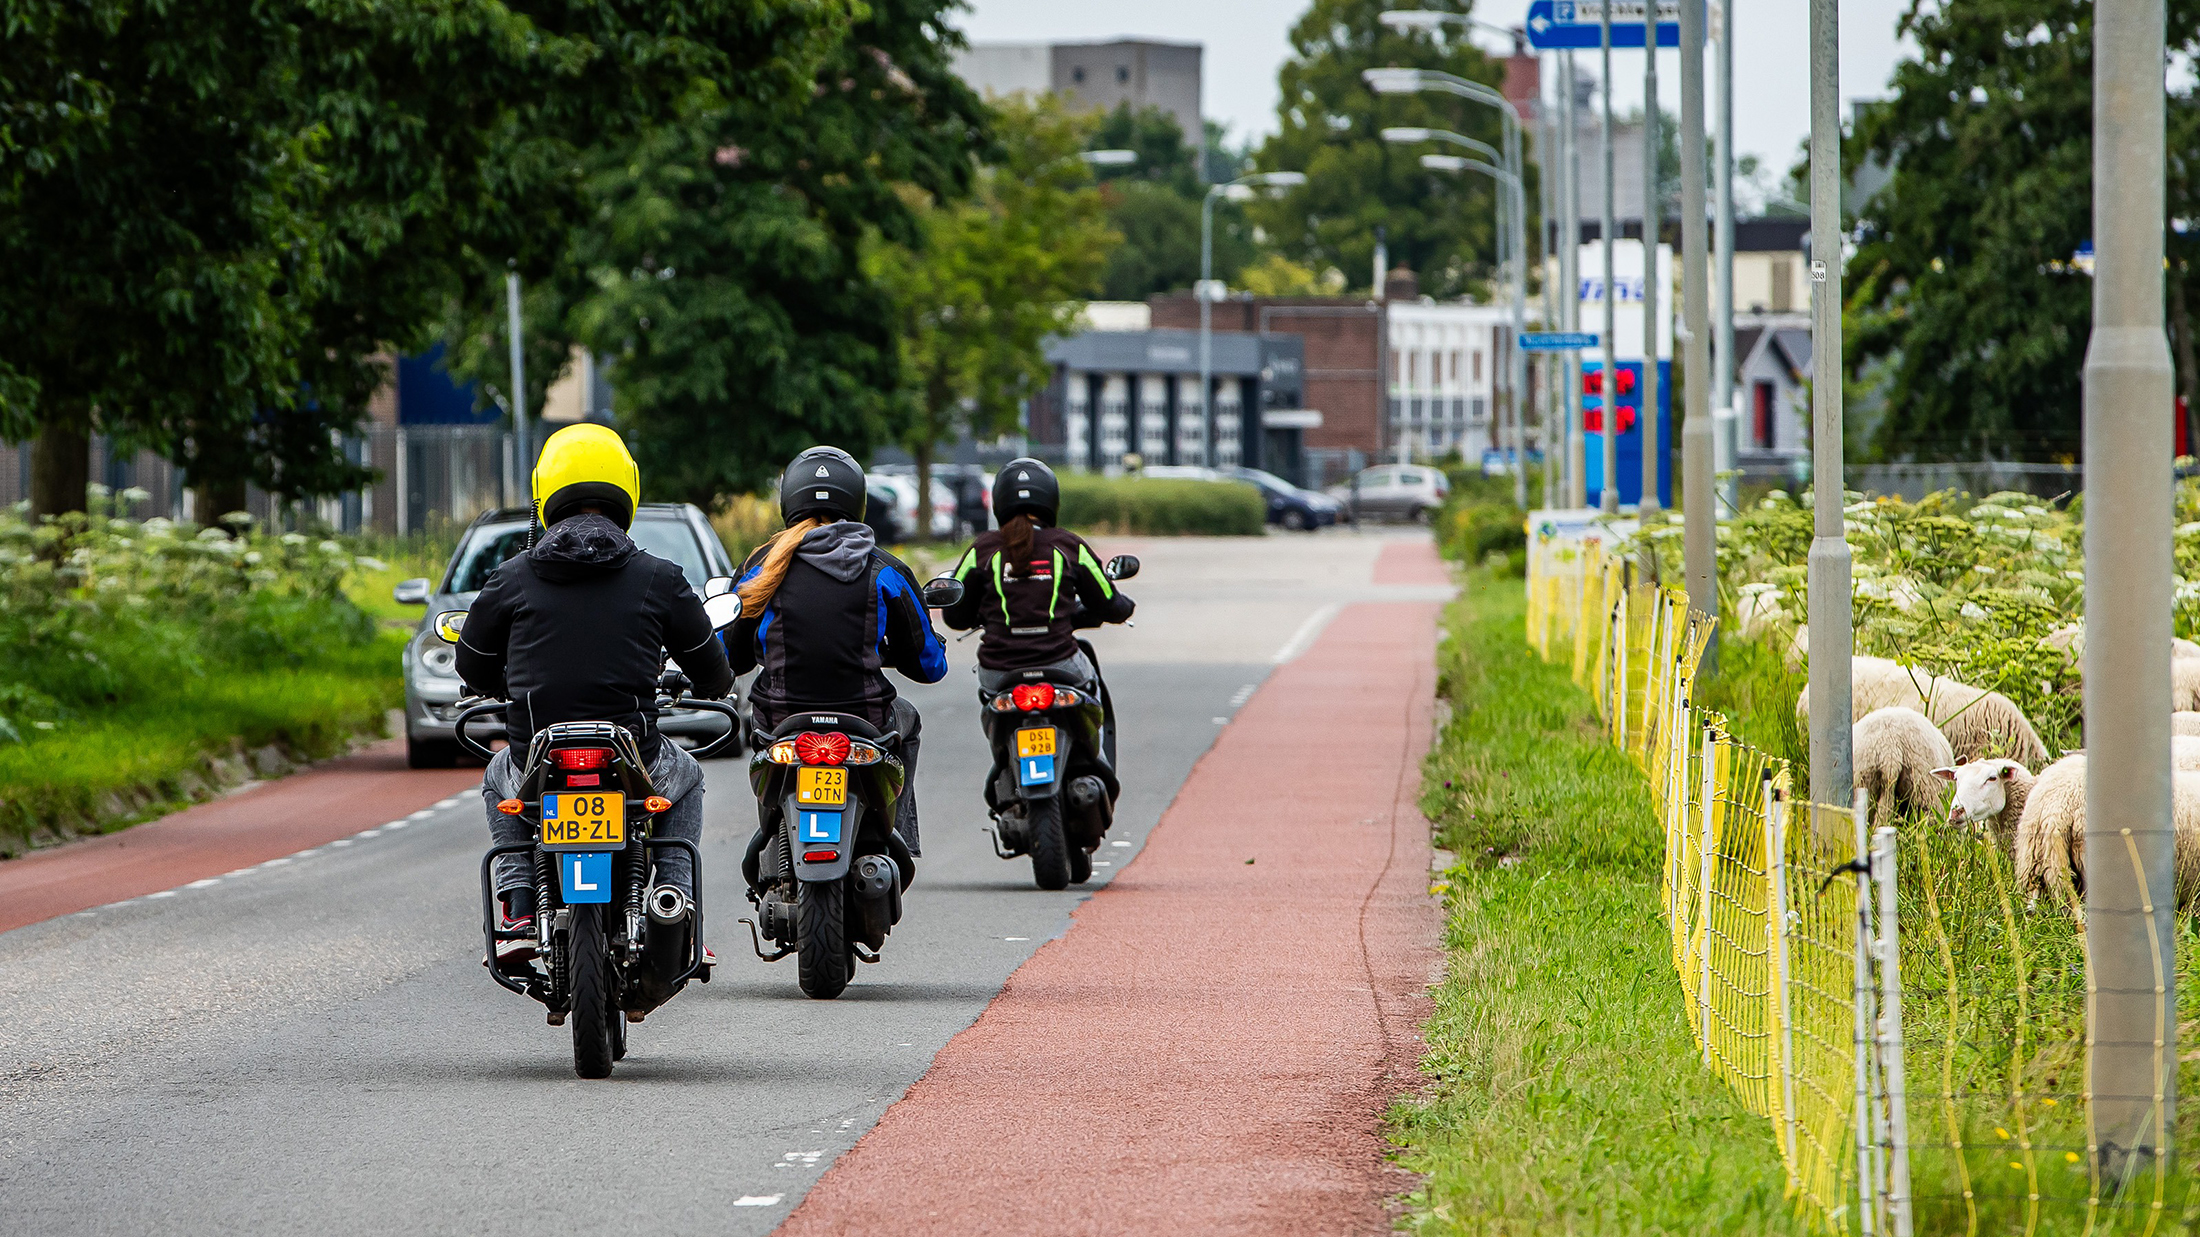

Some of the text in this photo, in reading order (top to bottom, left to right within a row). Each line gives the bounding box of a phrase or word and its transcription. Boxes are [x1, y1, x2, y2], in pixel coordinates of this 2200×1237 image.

[811, 716, 838, 724] YAMAHA
[1030, 731, 1050, 741] DSL
[1030, 743, 1051, 753] 92B
[815, 771, 842, 785] F23
[1029, 760, 1047, 779] L
[573, 797, 605, 816] 08
[547, 820, 618, 840] MB-ZL
[810, 814, 829, 838] L
[574, 861, 597, 891] L
